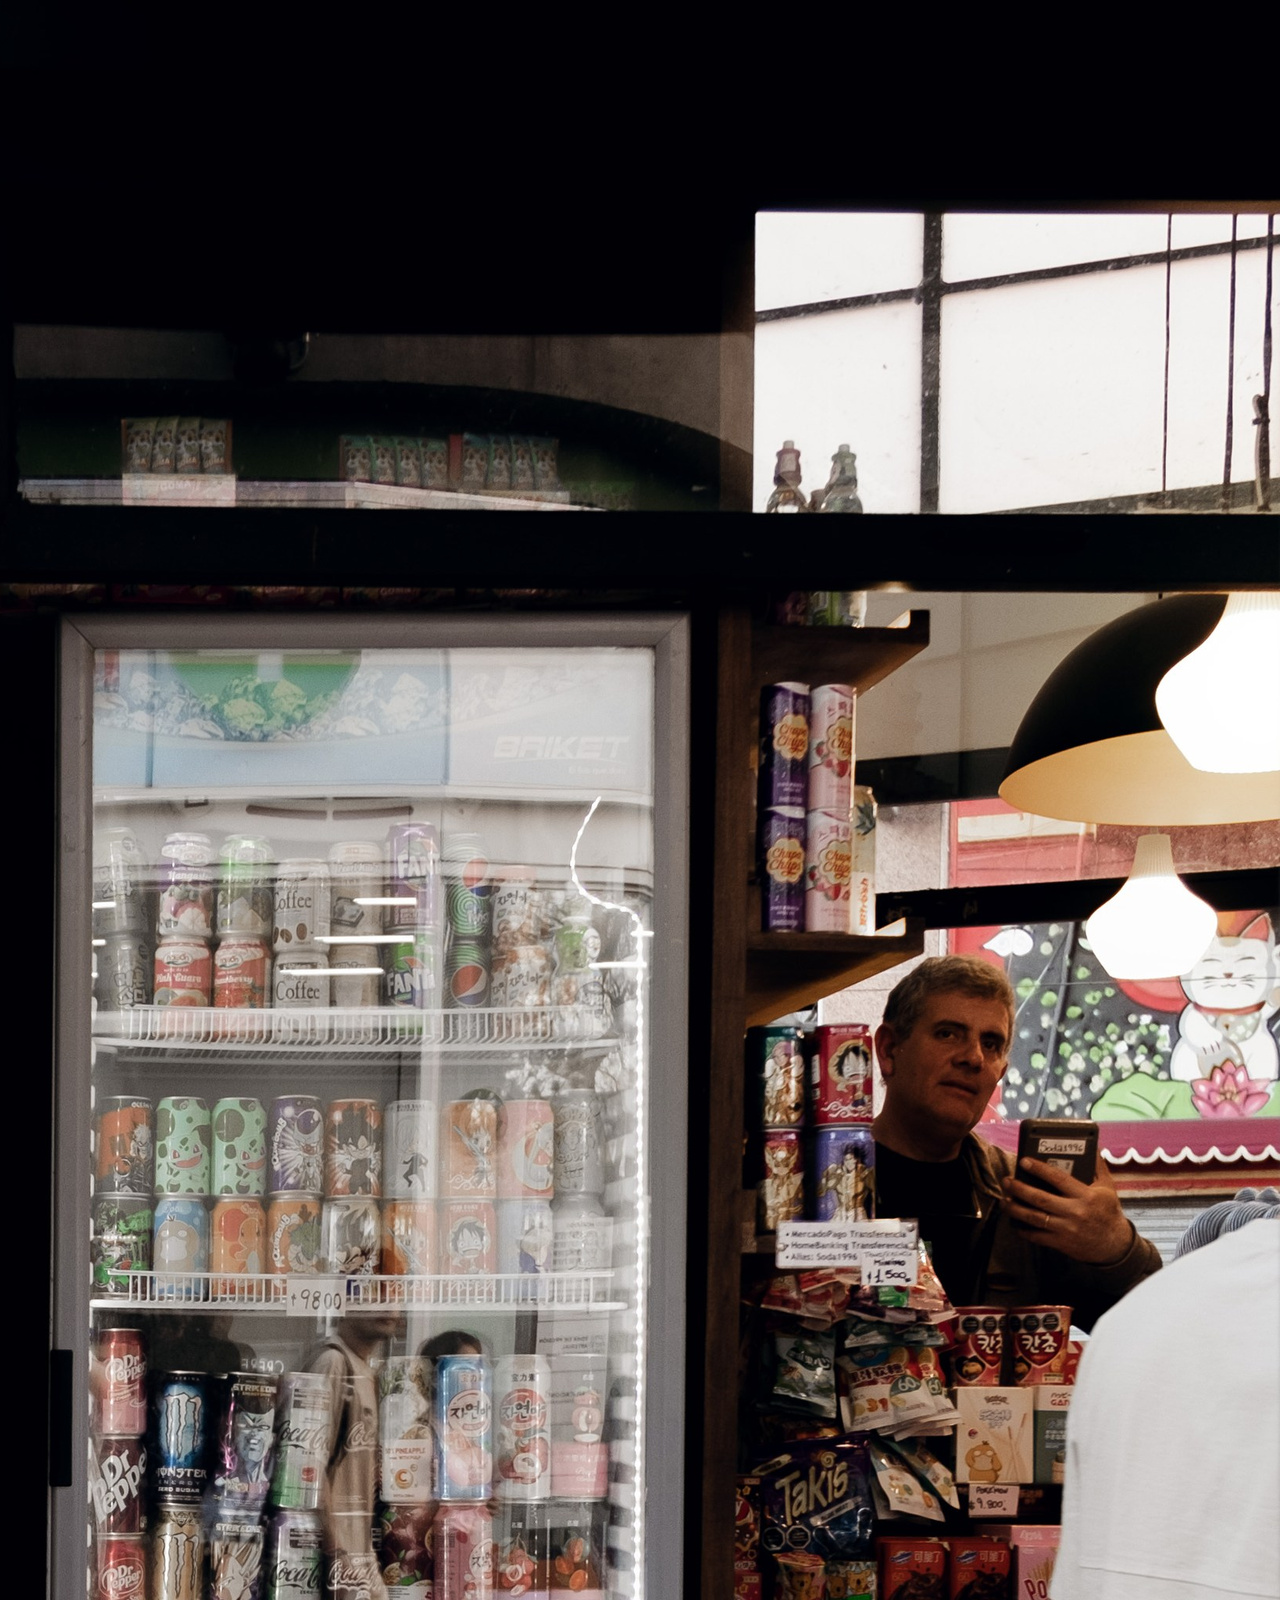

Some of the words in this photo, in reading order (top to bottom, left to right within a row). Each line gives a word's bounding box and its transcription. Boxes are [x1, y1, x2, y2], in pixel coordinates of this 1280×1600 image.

[494, 735, 630, 759] BRIKET
[276, 981, 320, 1000] Coffee
[791, 1230, 847, 1240] MercadoPago
[850, 1230, 907, 1239] Transferencia
[791, 1242, 848, 1251] HomeBanking
[1022, 1334, 1058, 1354] 칸초
[101, 1449, 130, 1481] Dr
[775, 1452, 849, 1526] Takis
[107, 1568, 141, 1588] Pepper
